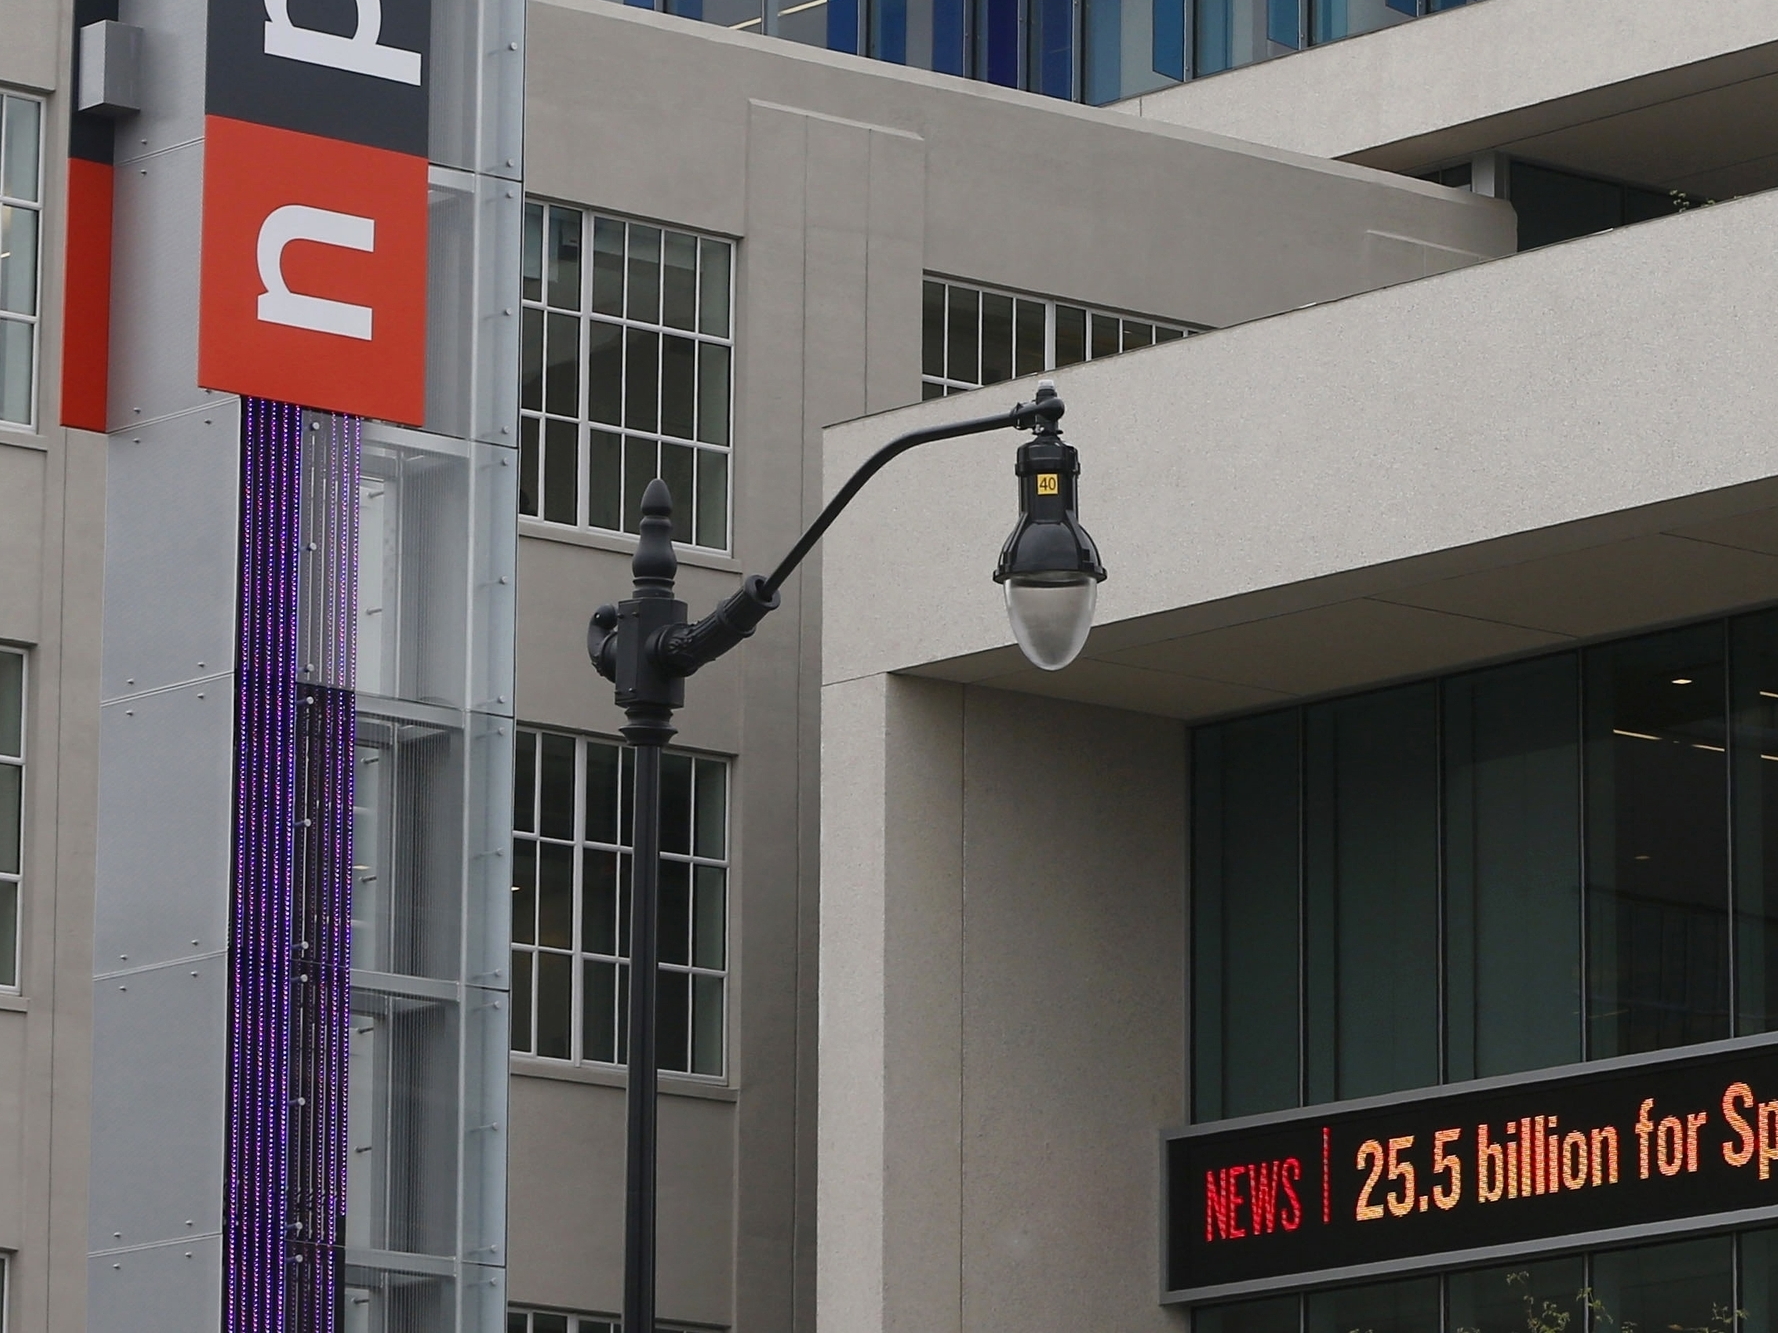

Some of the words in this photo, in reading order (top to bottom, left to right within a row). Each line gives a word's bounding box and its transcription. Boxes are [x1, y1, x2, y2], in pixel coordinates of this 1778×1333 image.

[1039, 477, 1057, 491] 40
[1206, 1157, 1302, 1242] NEWS
[1355, 1128, 1462, 1221] 25.5
[1477, 1115, 1619, 1202] billion
[1634, 1098, 1708, 1180] for
